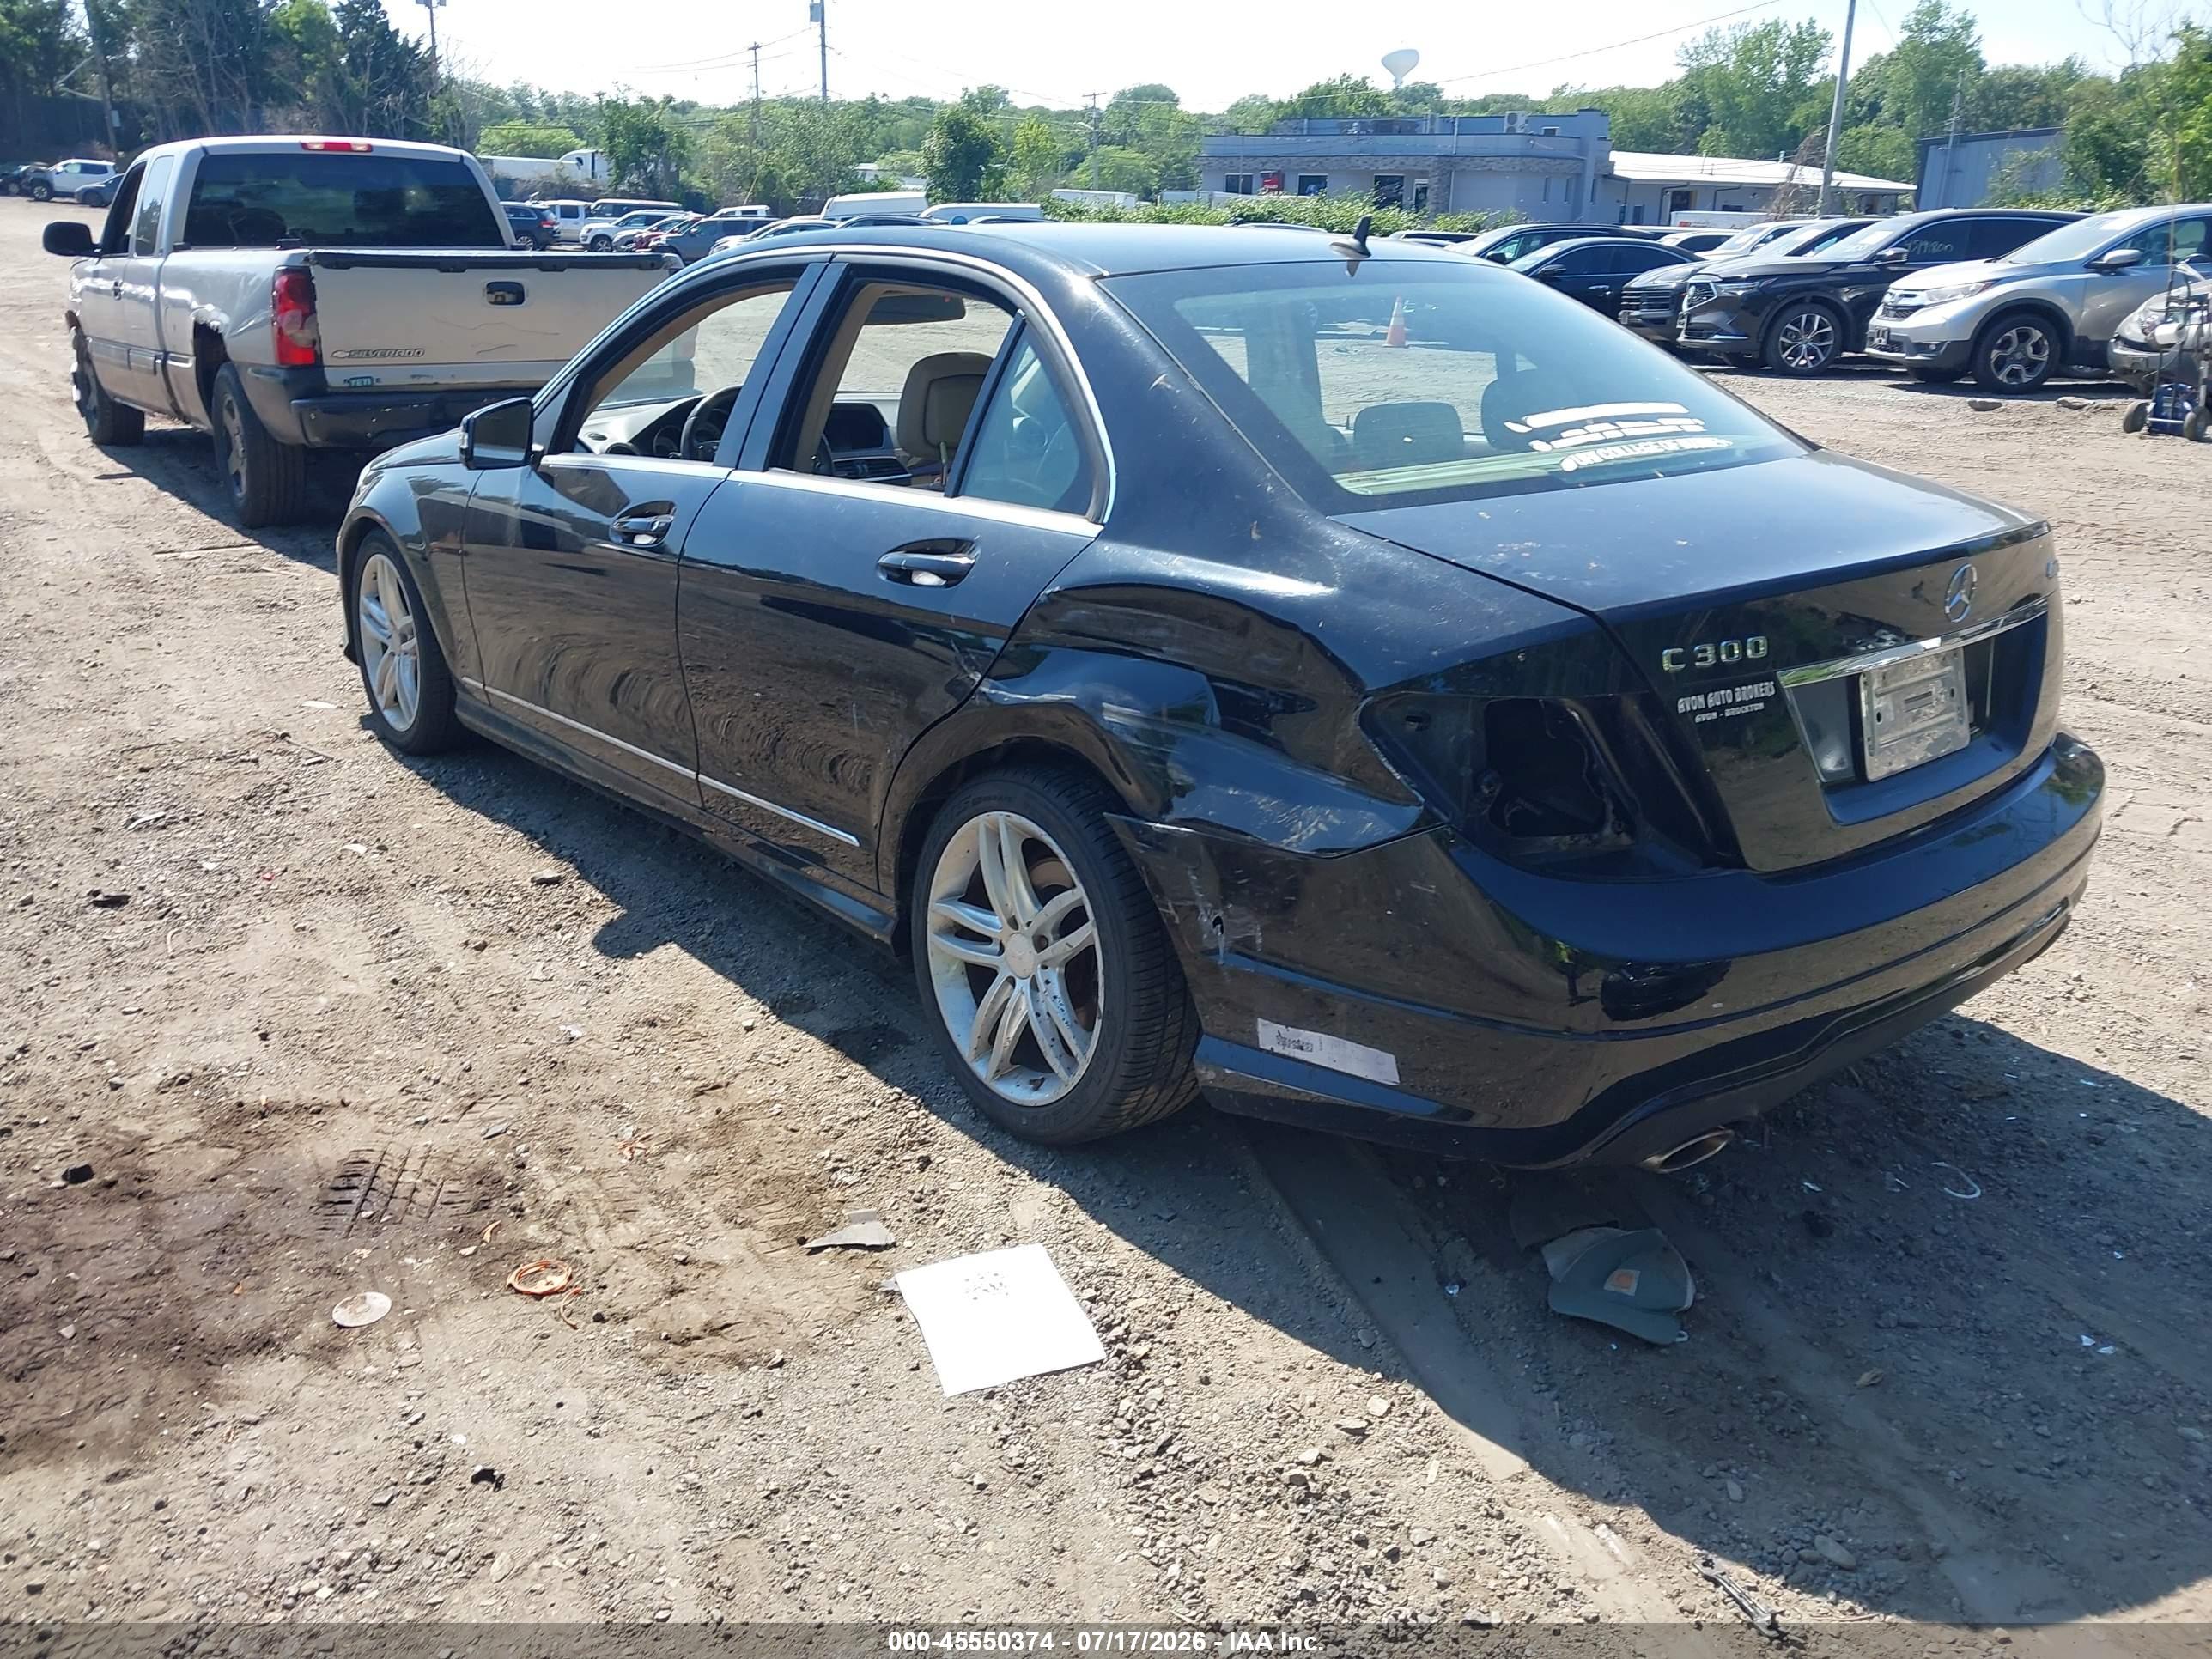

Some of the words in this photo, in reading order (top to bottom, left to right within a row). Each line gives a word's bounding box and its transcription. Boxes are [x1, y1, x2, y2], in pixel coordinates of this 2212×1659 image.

[348, 349, 426, 358] SILVERADO
[1694, 636, 1768, 667] 300
[1677, 694, 1706, 714] AVON
[1707, 690, 1733, 708] AUTO
[1735, 681, 1776, 702] BROKERS
